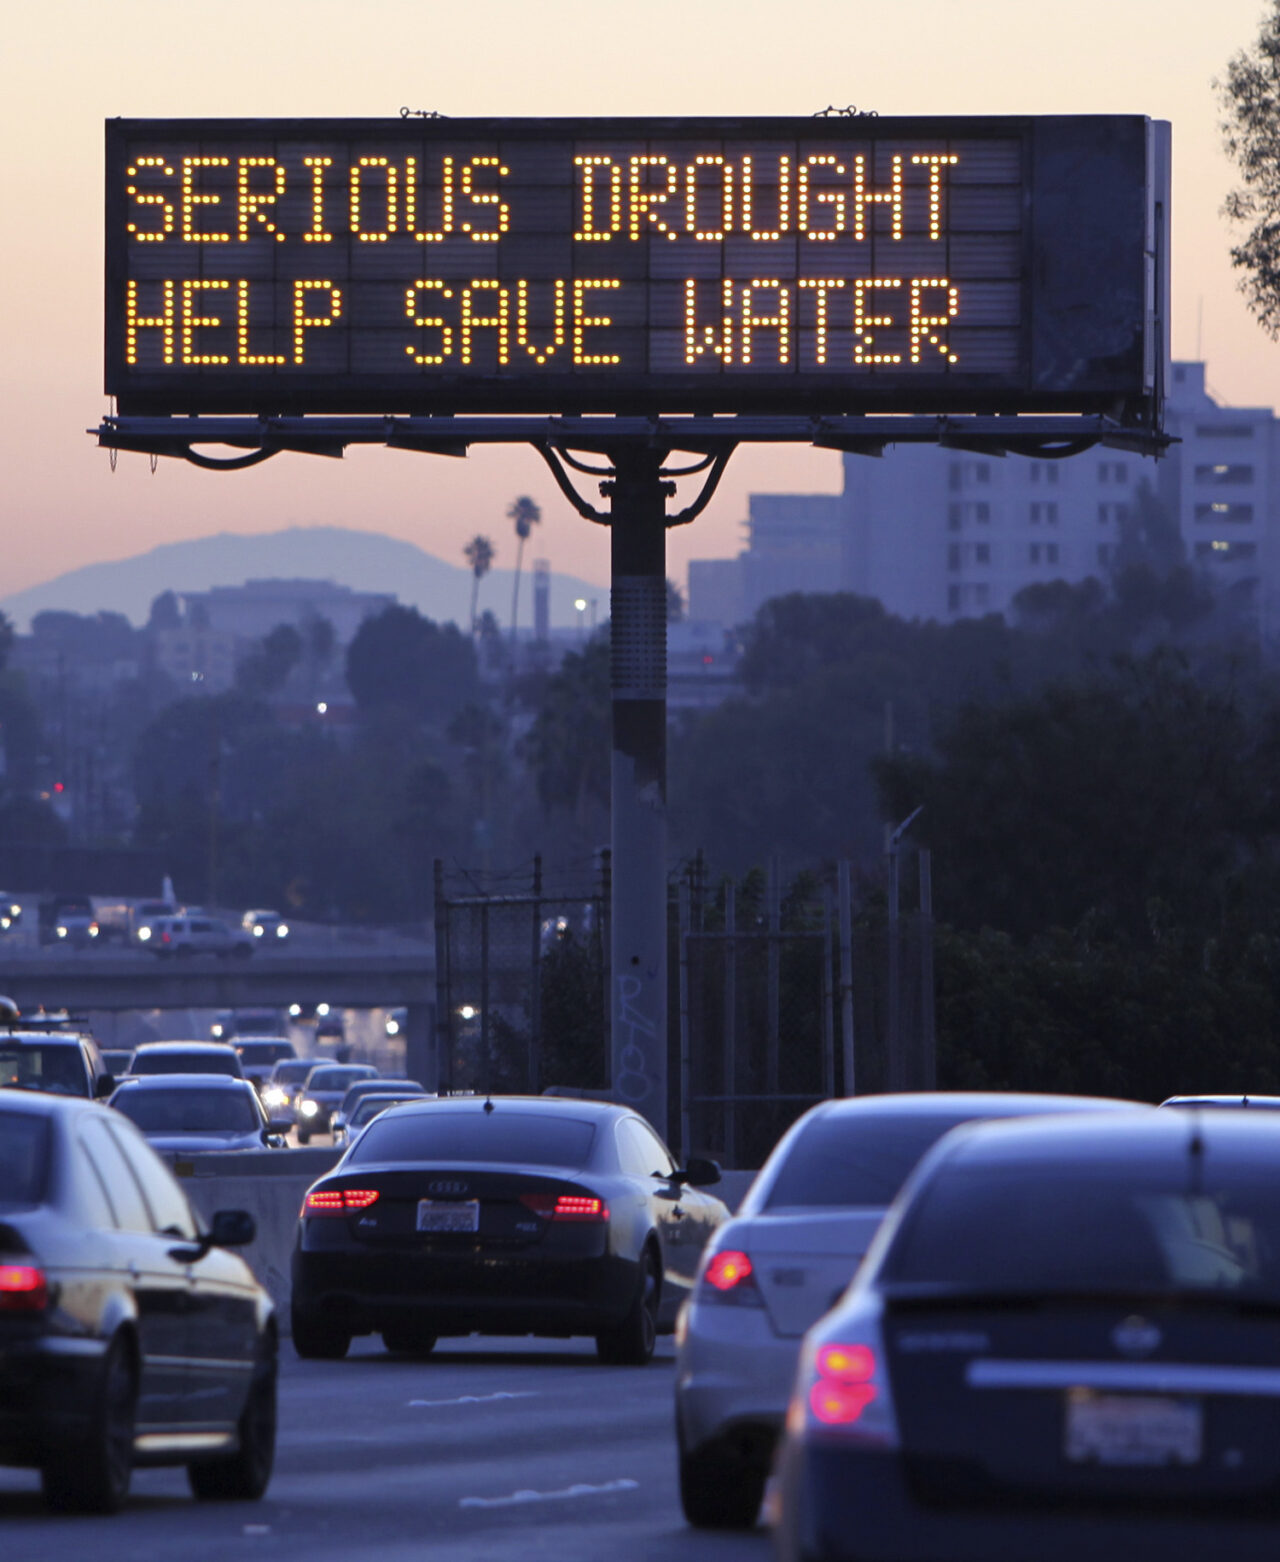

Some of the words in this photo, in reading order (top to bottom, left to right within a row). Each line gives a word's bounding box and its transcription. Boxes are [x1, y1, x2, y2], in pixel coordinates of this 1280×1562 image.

[127, 157, 509, 242] SERIOUS
[574, 155, 959, 241] DROUGHT
[127, 280, 341, 364] HELP
[406, 279, 620, 364] SAVE
[684, 278, 959, 364] WATER
